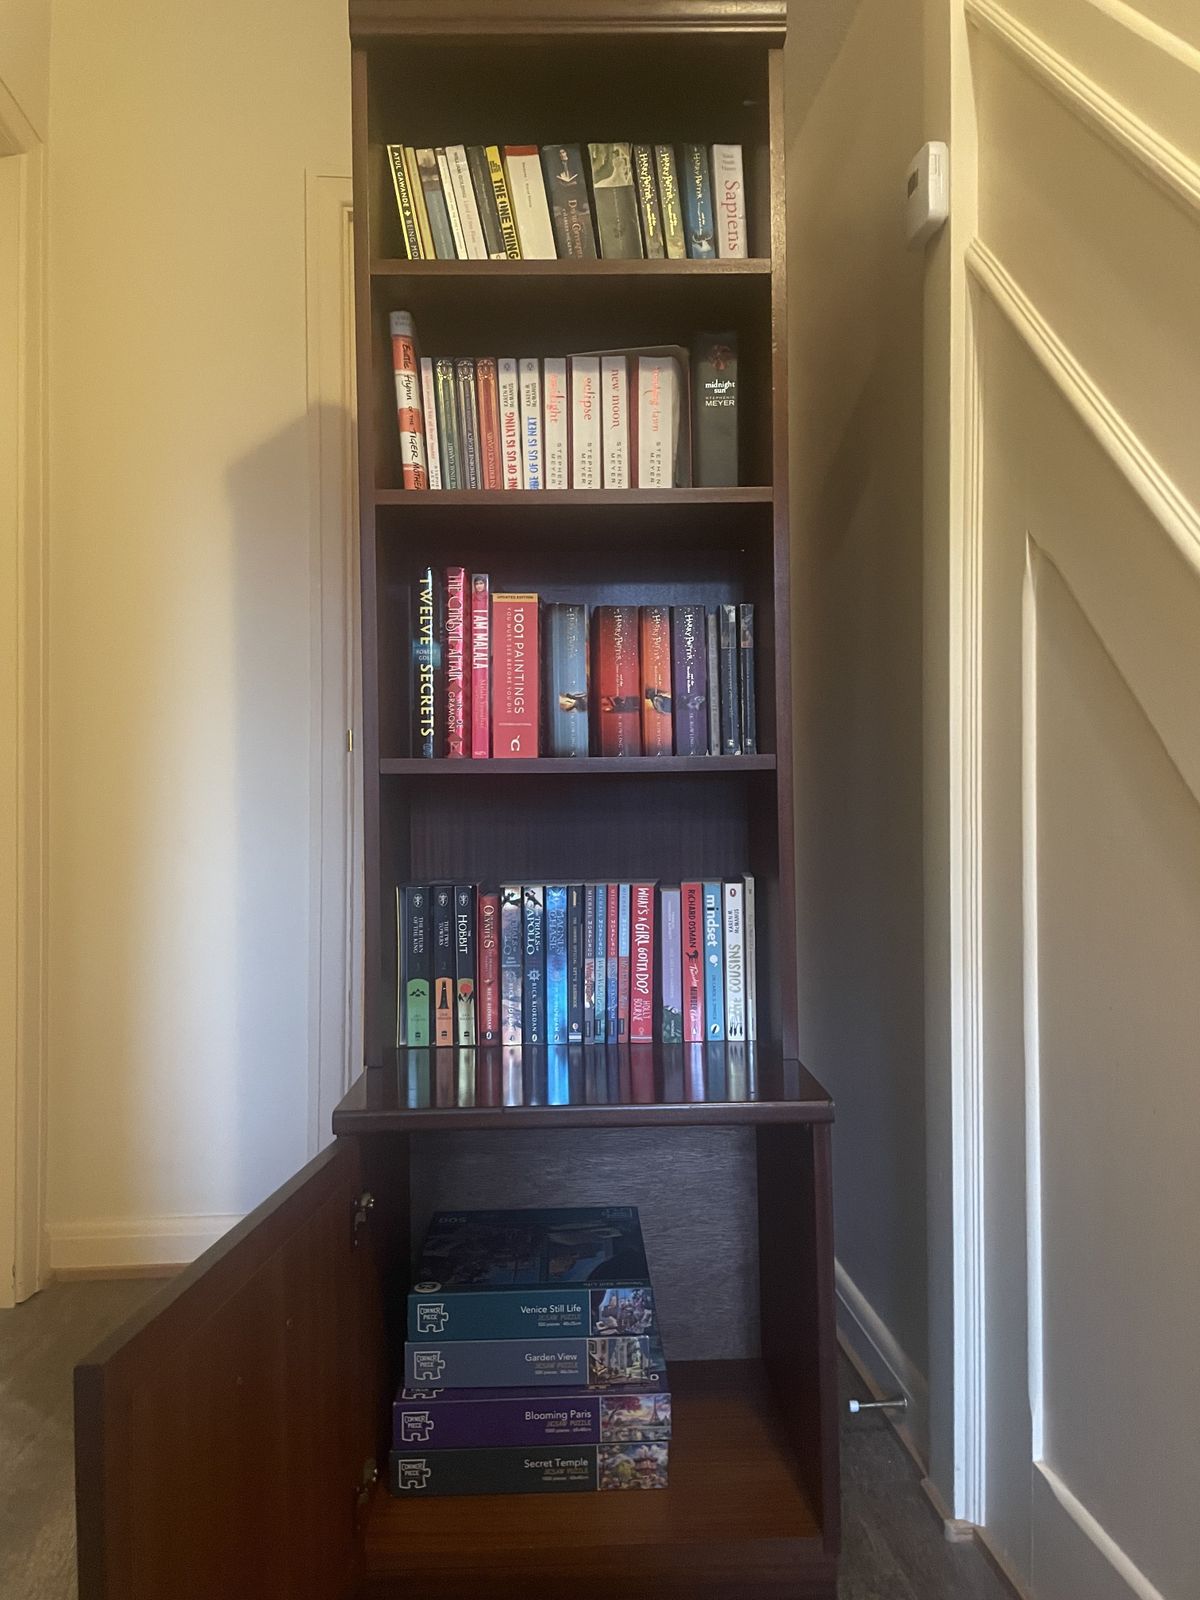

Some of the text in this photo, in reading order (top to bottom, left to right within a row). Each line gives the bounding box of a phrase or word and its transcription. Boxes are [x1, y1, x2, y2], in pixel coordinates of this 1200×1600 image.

[393, 151, 403, 170] ATUL
[661, 153, 671, 175] HARRY
[397, 171, 410, 208] GAWANDE
[493, 178, 506, 199] THE
[662, 174, 674, 201] POTTER
[497, 200, 510, 225] ONE
[720, 180, 742, 252] Sapiens
[405, 219, 417, 243] BEING
[503, 224, 519, 259] THING
[402, 343, 411, 370] Battle
[402, 374, 414, 402] Hymn
[705, 379, 736, 390] midnight
[579, 377, 597, 421] eclipse
[611, 370, 621, 430] new moon
[527, 416, 538, 437] NEXT
[410, 430, 420, 461] TIGER
[504, 411, 518, 475] OF US IS LYING
[527, 439, 538, 448] IS
[528, 450, 538, 461] US
[528, 463, 539, 474] OF
[419, 577, 434, 646] TWELVE
[472, 615, 488, 630] AM
[684, 613, 695, 636] HARRY
[445, 574, 463, 682] THE CHRISTIE AFFAIR
[473, 632, 489, 670] MALALA
[513, 607, 525, 714] 1001 PAINTINGS
[685, 636, 697, 661] POTTER
[420, 663, 435, 738] SECRETS
[448, 691, 456, 733] GRAMONT
[637, 887, 650, 915] WHAT'S
[483, 905, 495, 949] OLYMPUS
[526, 908, 536, 956] APOLLO
[534, 916, 542, 946] TRIALS
[548, 911, 557, 951] CHASE
[554, 908, 565, 956] MAGNUS
[687, 889, 699, 949] RICHARD OSMAN
[706, 895, 720, 947] mindset
[457, 914, 468, 955] HOBBIT
[634, 923, 651, 947] GIRL
[638, 947, 649, 972] GOTTA
[728, 943, 742, 994] COUSINS
[634, 973, 650, 995] DO?
[632, 998, 643, 1022] BOURNE
[642, 1000, 651, 1019] HOLLY
[520, 1303, 582, 1314] Venice Still Life
[525, 1353, 556, 1362] Garden
[525, 1409, 592, 1421] Blooming Paris
[524, 1458, 588, 1469] Secret Temple
